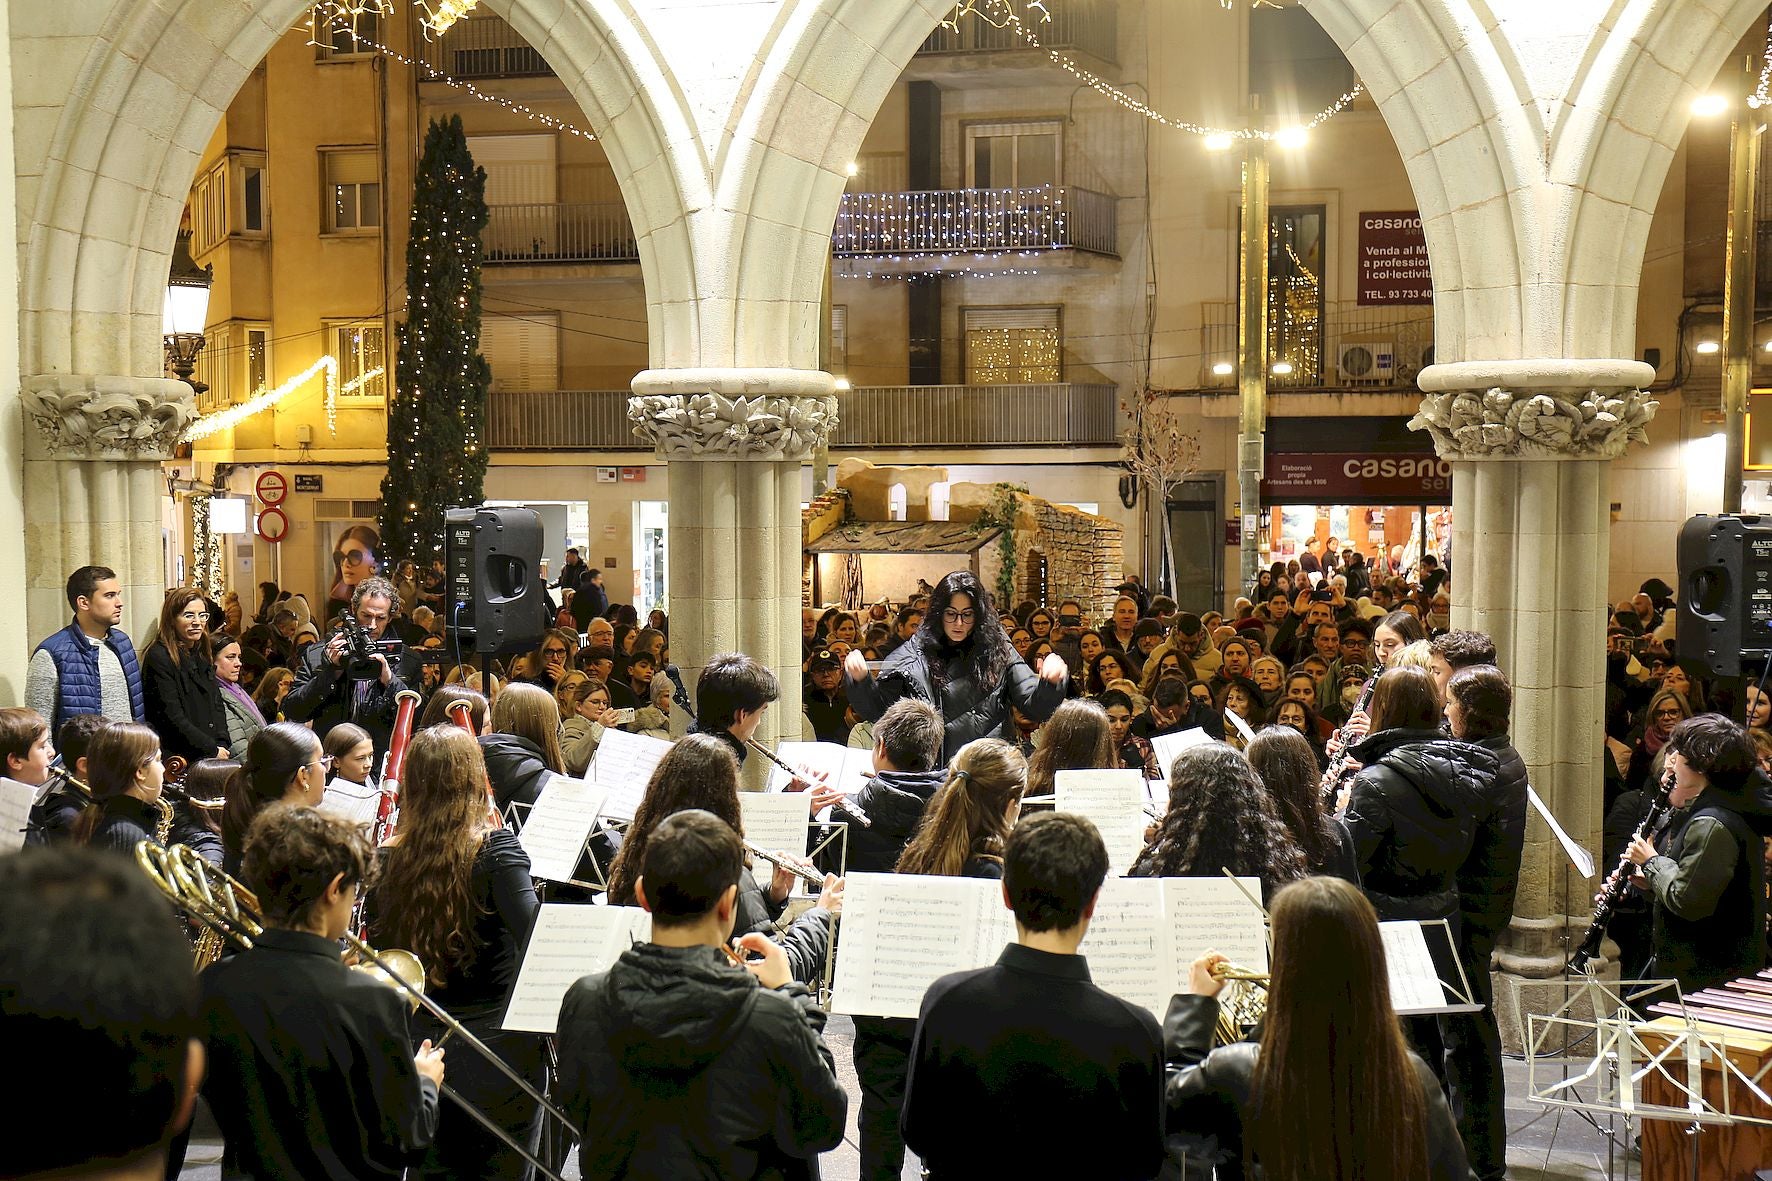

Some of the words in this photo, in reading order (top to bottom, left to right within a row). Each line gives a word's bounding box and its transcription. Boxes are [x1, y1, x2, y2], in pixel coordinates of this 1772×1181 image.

[1364, 219, 1422, 229] casano
[1365, 246, 1400, 255] Venda
[1403, 246, 1413, 255] al
[1363, 260, 1370, 268] a
[1366, 270, 1370, 279] i
[1365, 290, 1386, 299] TEL.
[1388, 290, 1400, 298] 93
[1402, 289, 1419, 298] 733
[1421, 289, 1432, 298] 40
[1343, 459, 1453, 478] casano
